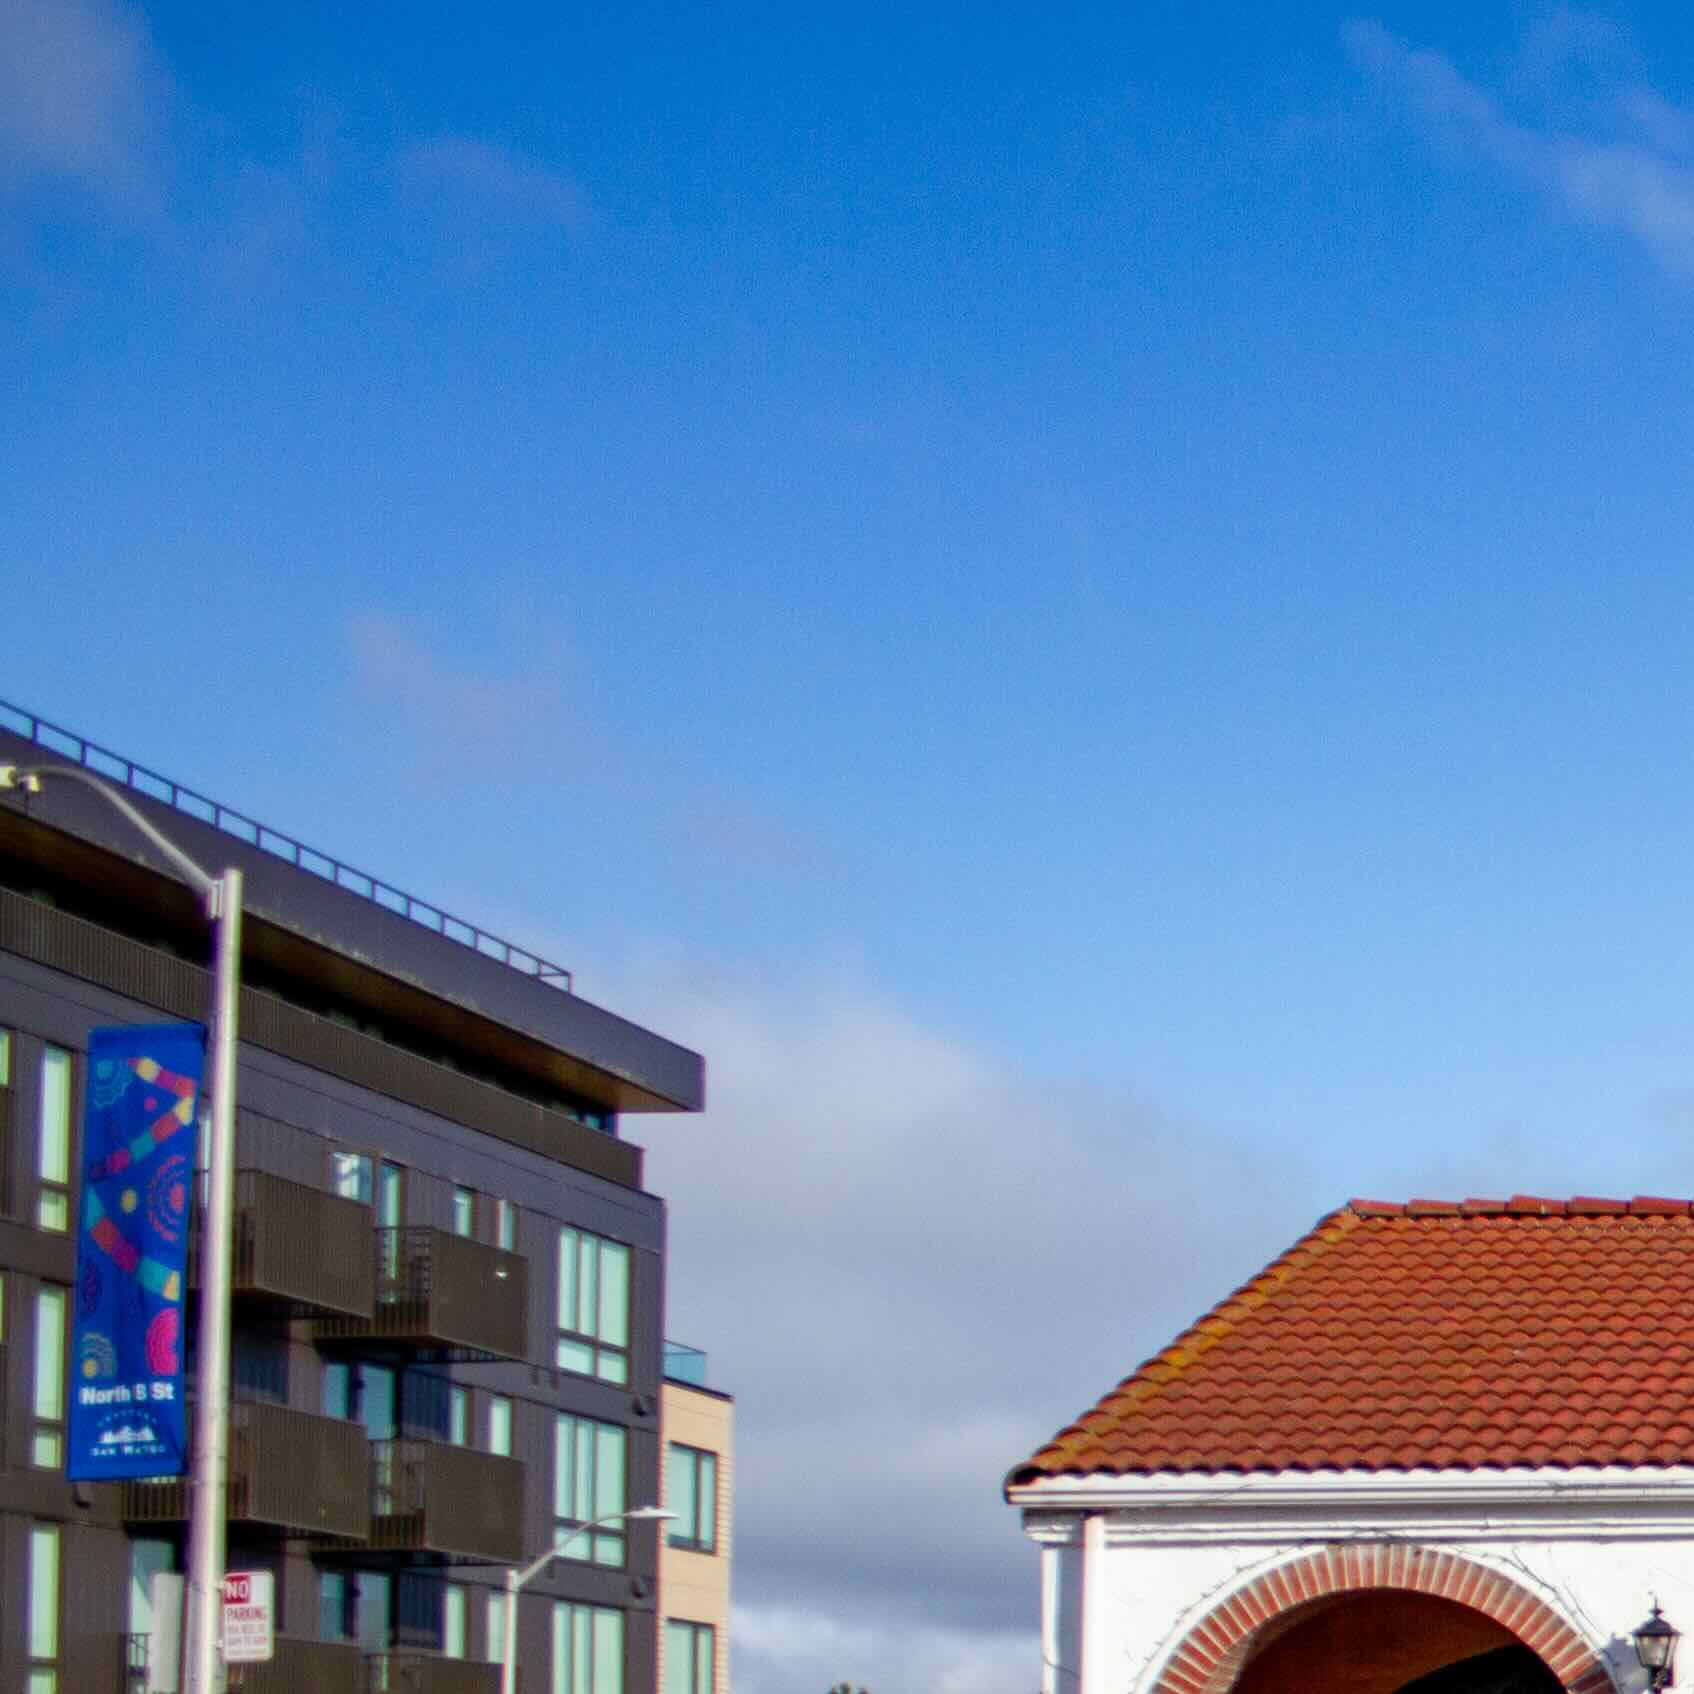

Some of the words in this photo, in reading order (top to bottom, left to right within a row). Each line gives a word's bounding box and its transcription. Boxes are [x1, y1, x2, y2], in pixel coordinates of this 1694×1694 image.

[79, 1385, 131, 1405] North
[151, 1381, 175, 1400] St
[226, 1580, 249, 1599] NO
